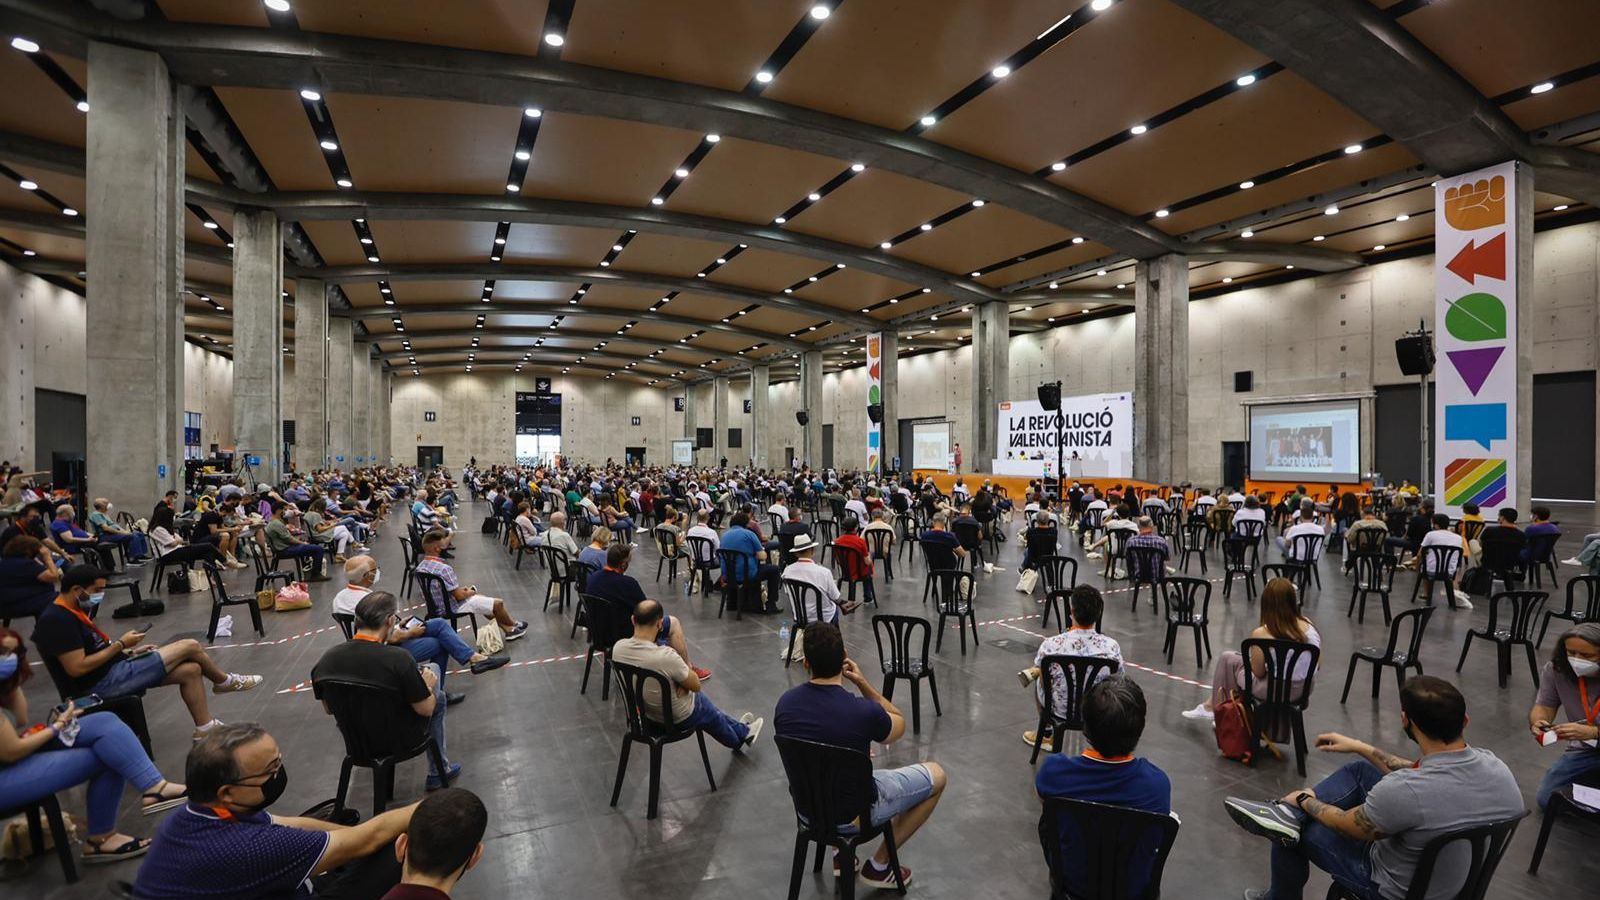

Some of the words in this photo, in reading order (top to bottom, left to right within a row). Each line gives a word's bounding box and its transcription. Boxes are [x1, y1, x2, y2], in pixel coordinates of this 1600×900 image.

[1009, 416, 1025, 431] LA
[1029, 406, 1113, 431] REVOLUCIÓ
[1009, 430, 1112, 448] VALENCIANISTA
